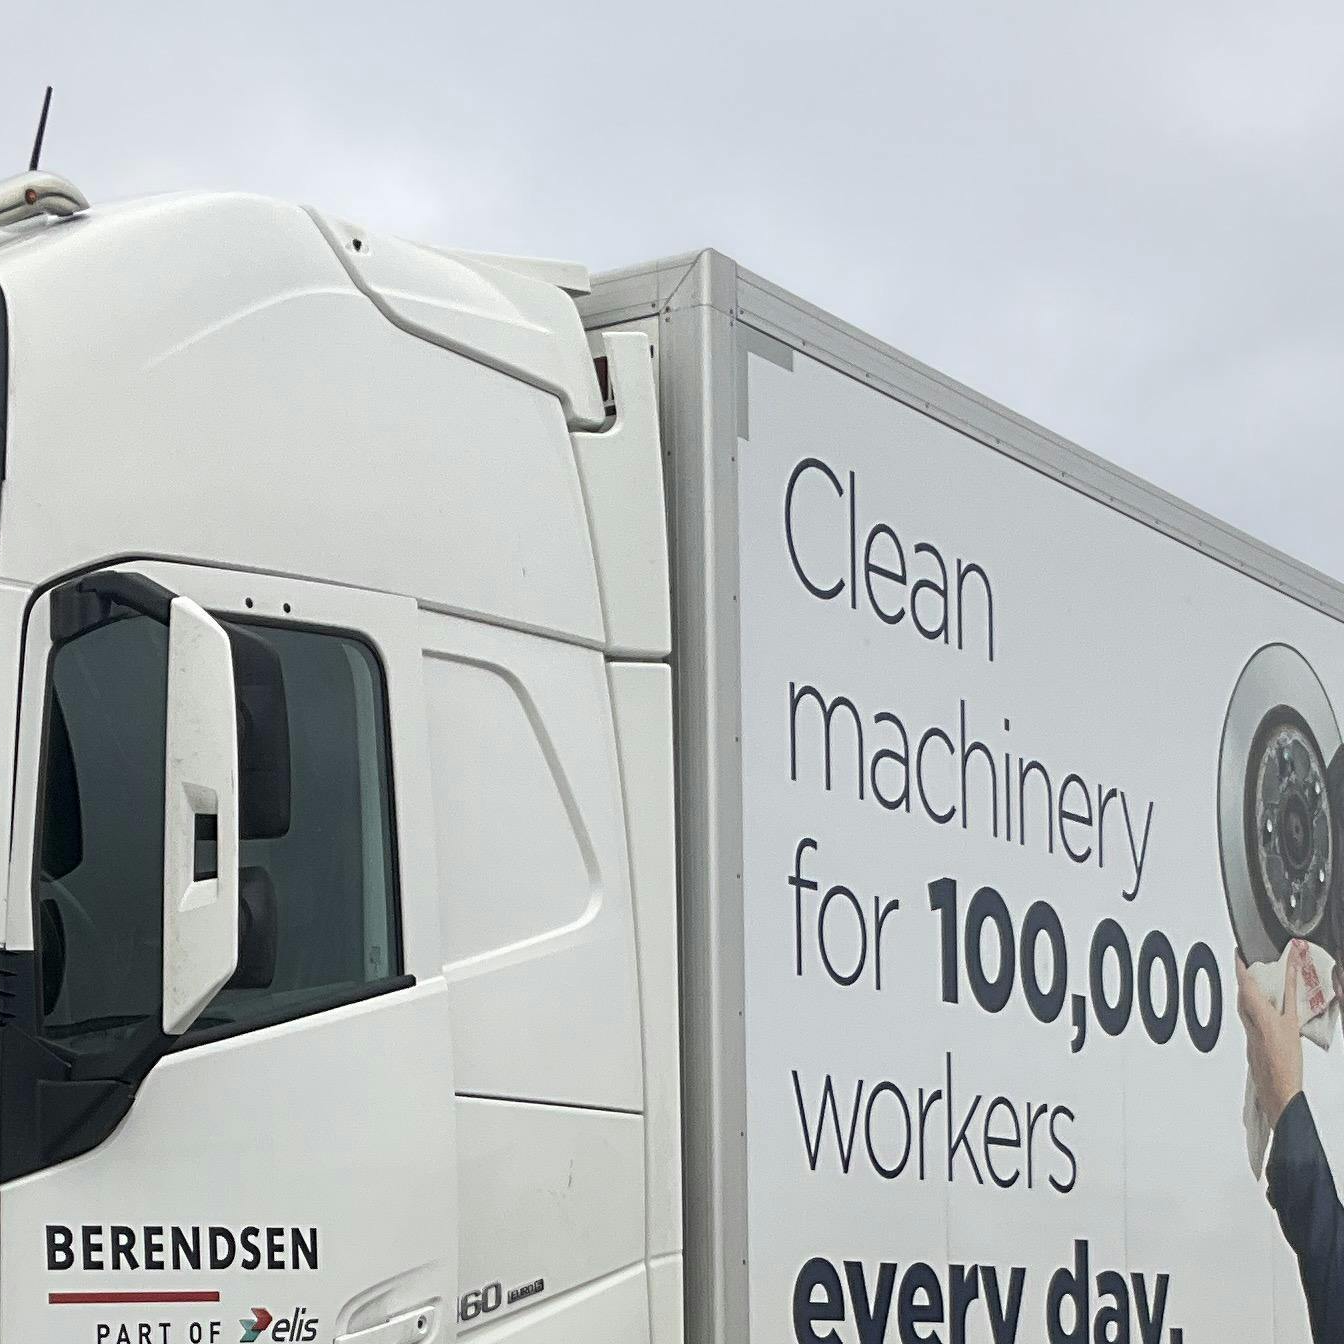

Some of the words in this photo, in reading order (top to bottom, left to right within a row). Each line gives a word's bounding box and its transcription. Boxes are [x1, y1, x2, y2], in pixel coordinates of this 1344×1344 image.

[784, 457, 994, 662] Clean
[789, 681, 1154, 900] machinery
[788, 838, 900, 990] for
[928, 877, 1223, 1053] 100,000
[792, 1052, 1077, 1193] workers
[45, 1224, 319, 1271] BERENDSEN
[189, 1321, 223, 1344] OF
[271, 1306, 319, 1343] elis
